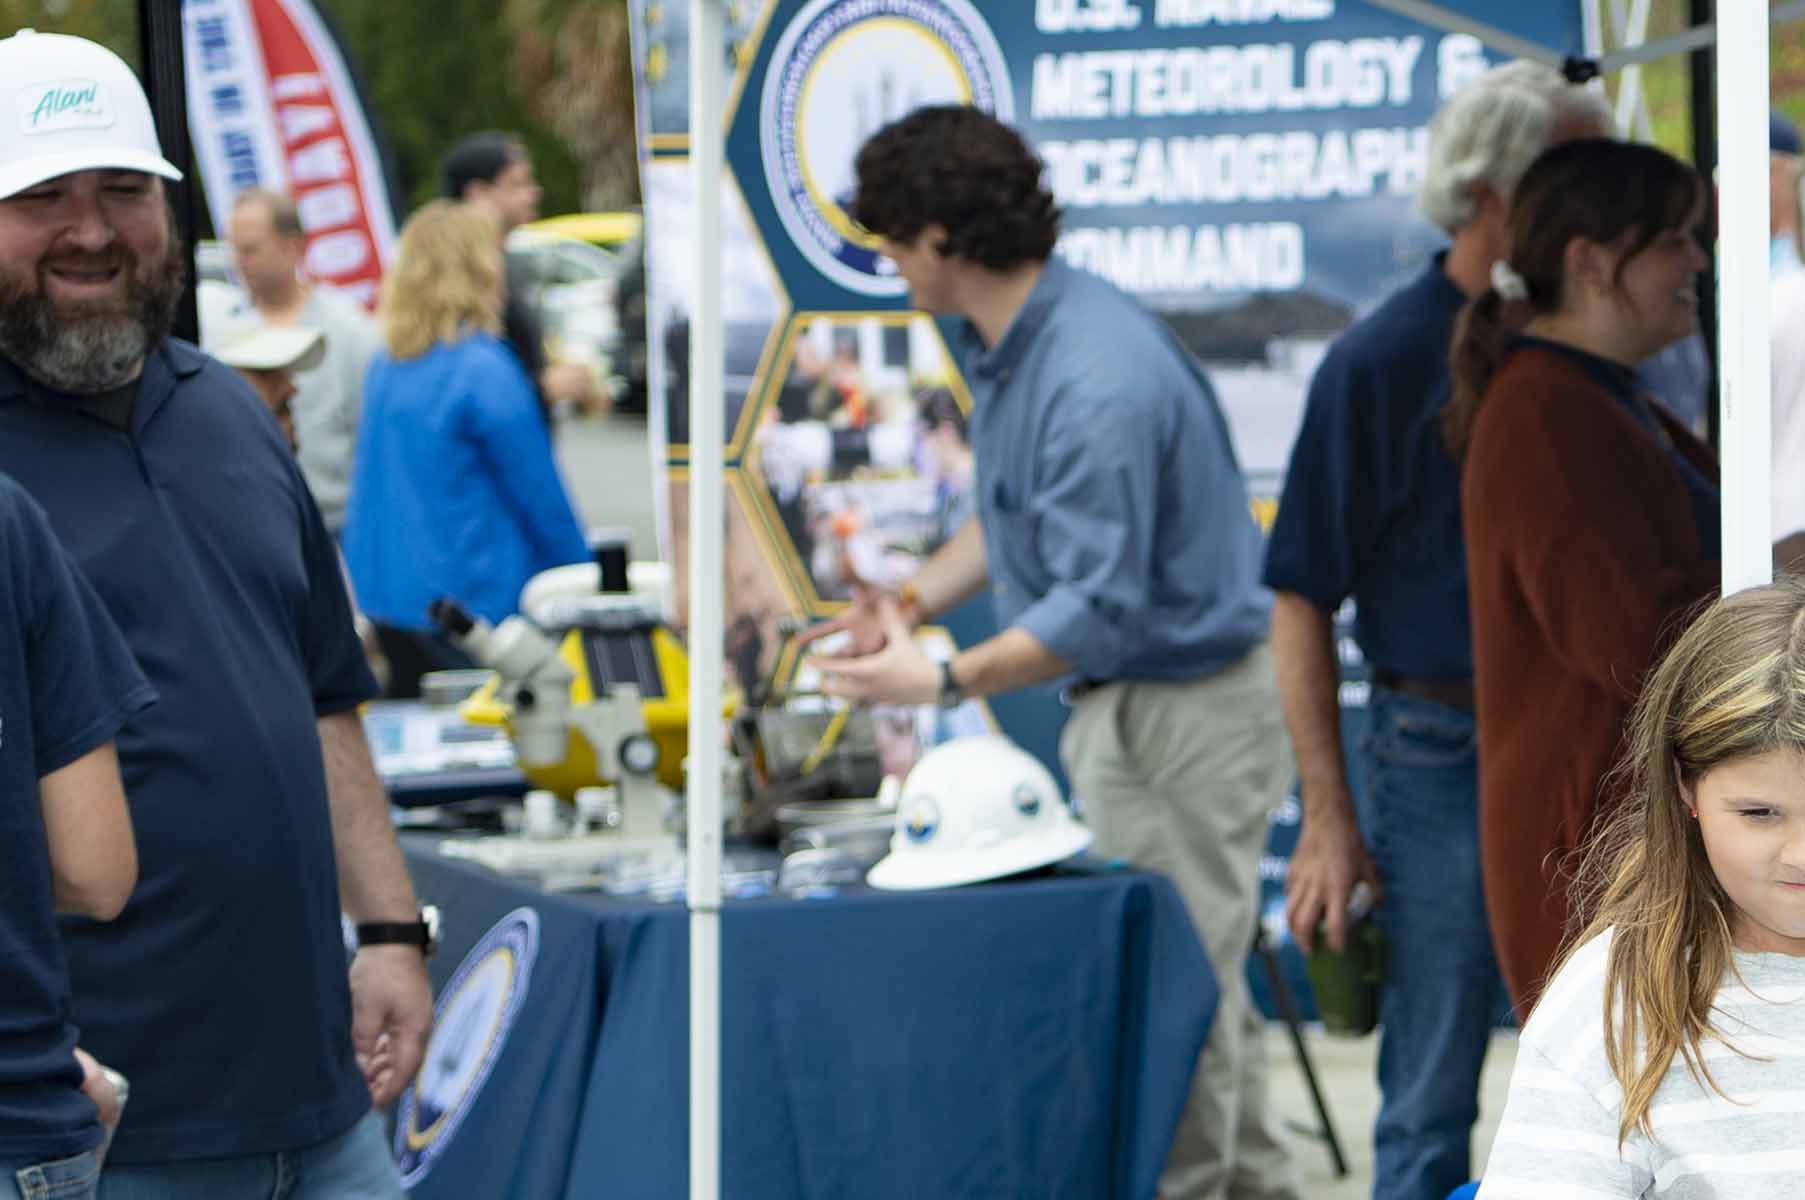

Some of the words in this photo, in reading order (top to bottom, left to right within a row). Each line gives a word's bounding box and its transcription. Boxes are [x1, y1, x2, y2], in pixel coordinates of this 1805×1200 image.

[32, 83, 97, 124] Alani
[1031, 35, 1423, 119] METEOROLOGY
[1038, 128, 1430, 207] OCEANOGRAPH
